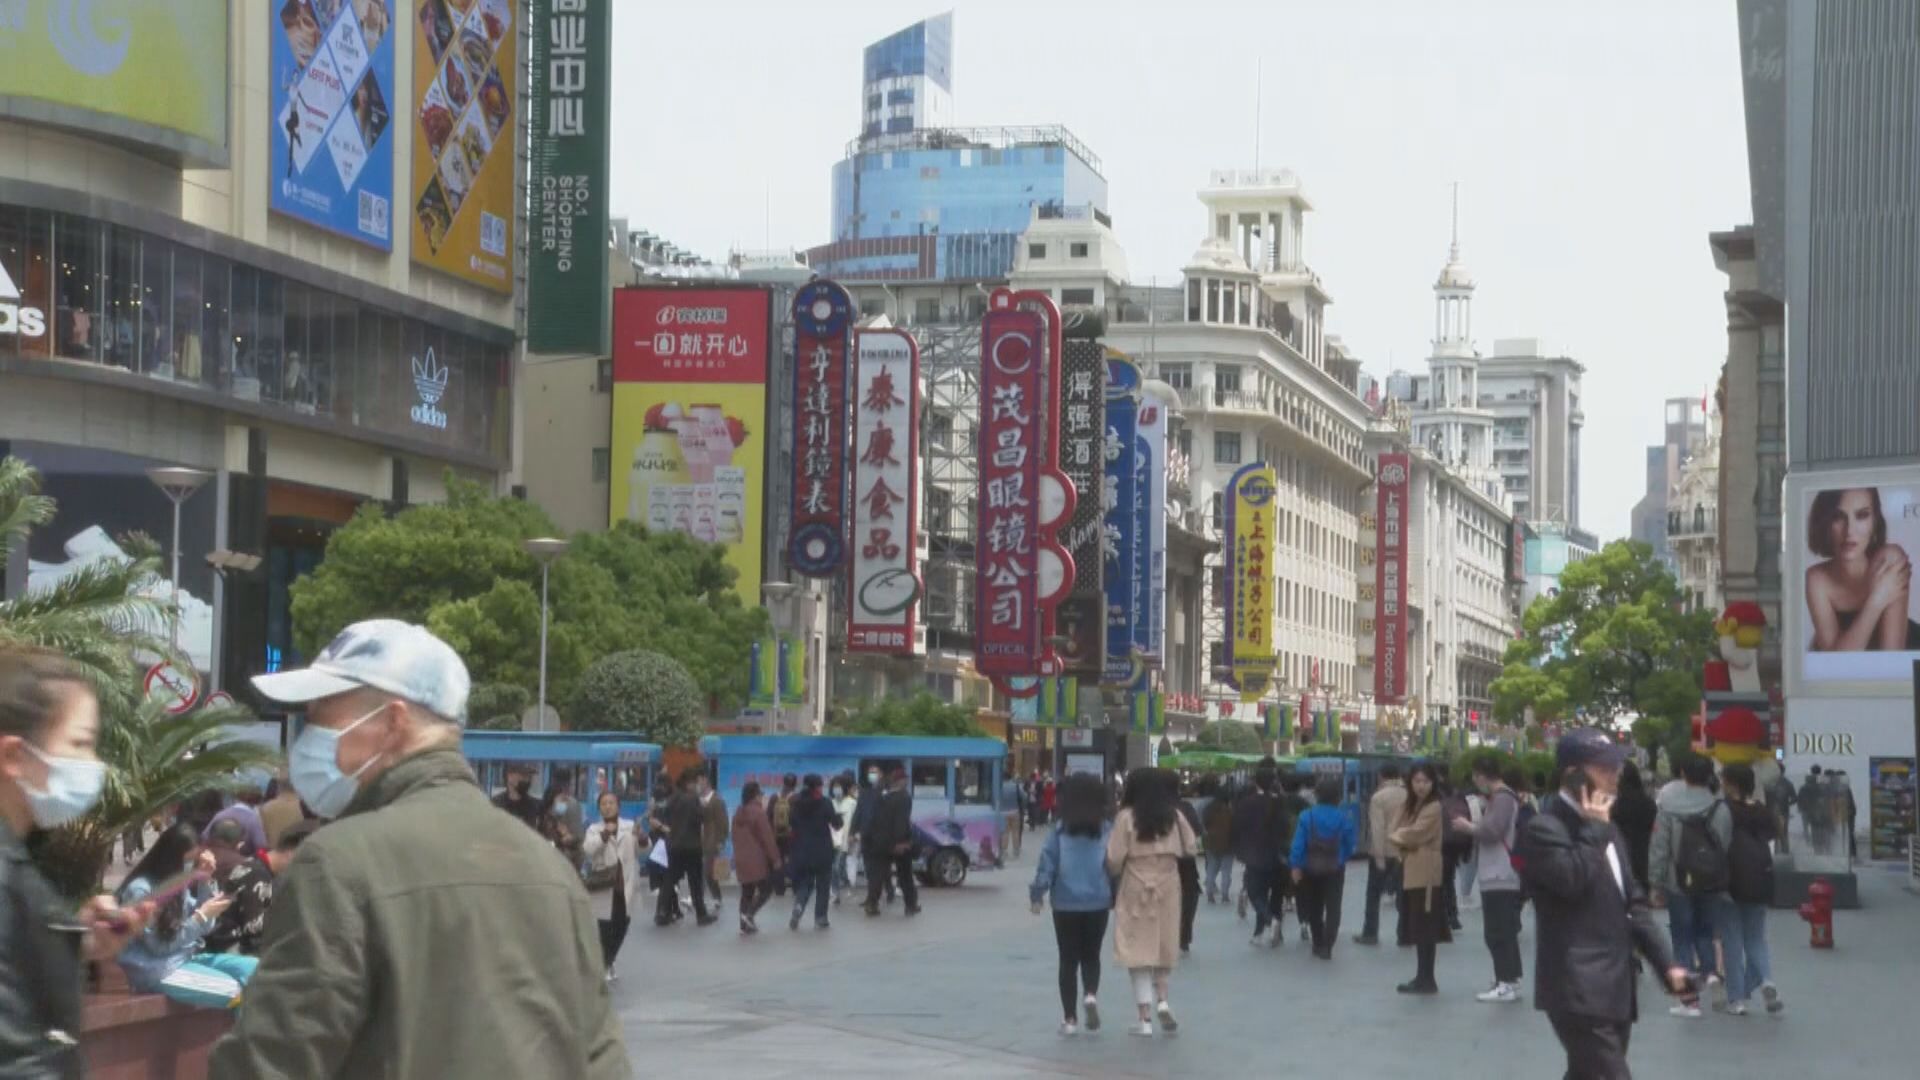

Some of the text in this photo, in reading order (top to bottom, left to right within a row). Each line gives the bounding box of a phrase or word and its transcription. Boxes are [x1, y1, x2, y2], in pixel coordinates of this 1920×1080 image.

[542, 175, 556, 251] CENTER
[558, 175, 573, 272] SHOPPING
[411, 403, 447, 428] adidas
[860, 363, 905, 561] 泰康食品
[985, 382, 1030, 630] 茂昌眼镜公司
[1793, 732, 1855, 756] DIOR
